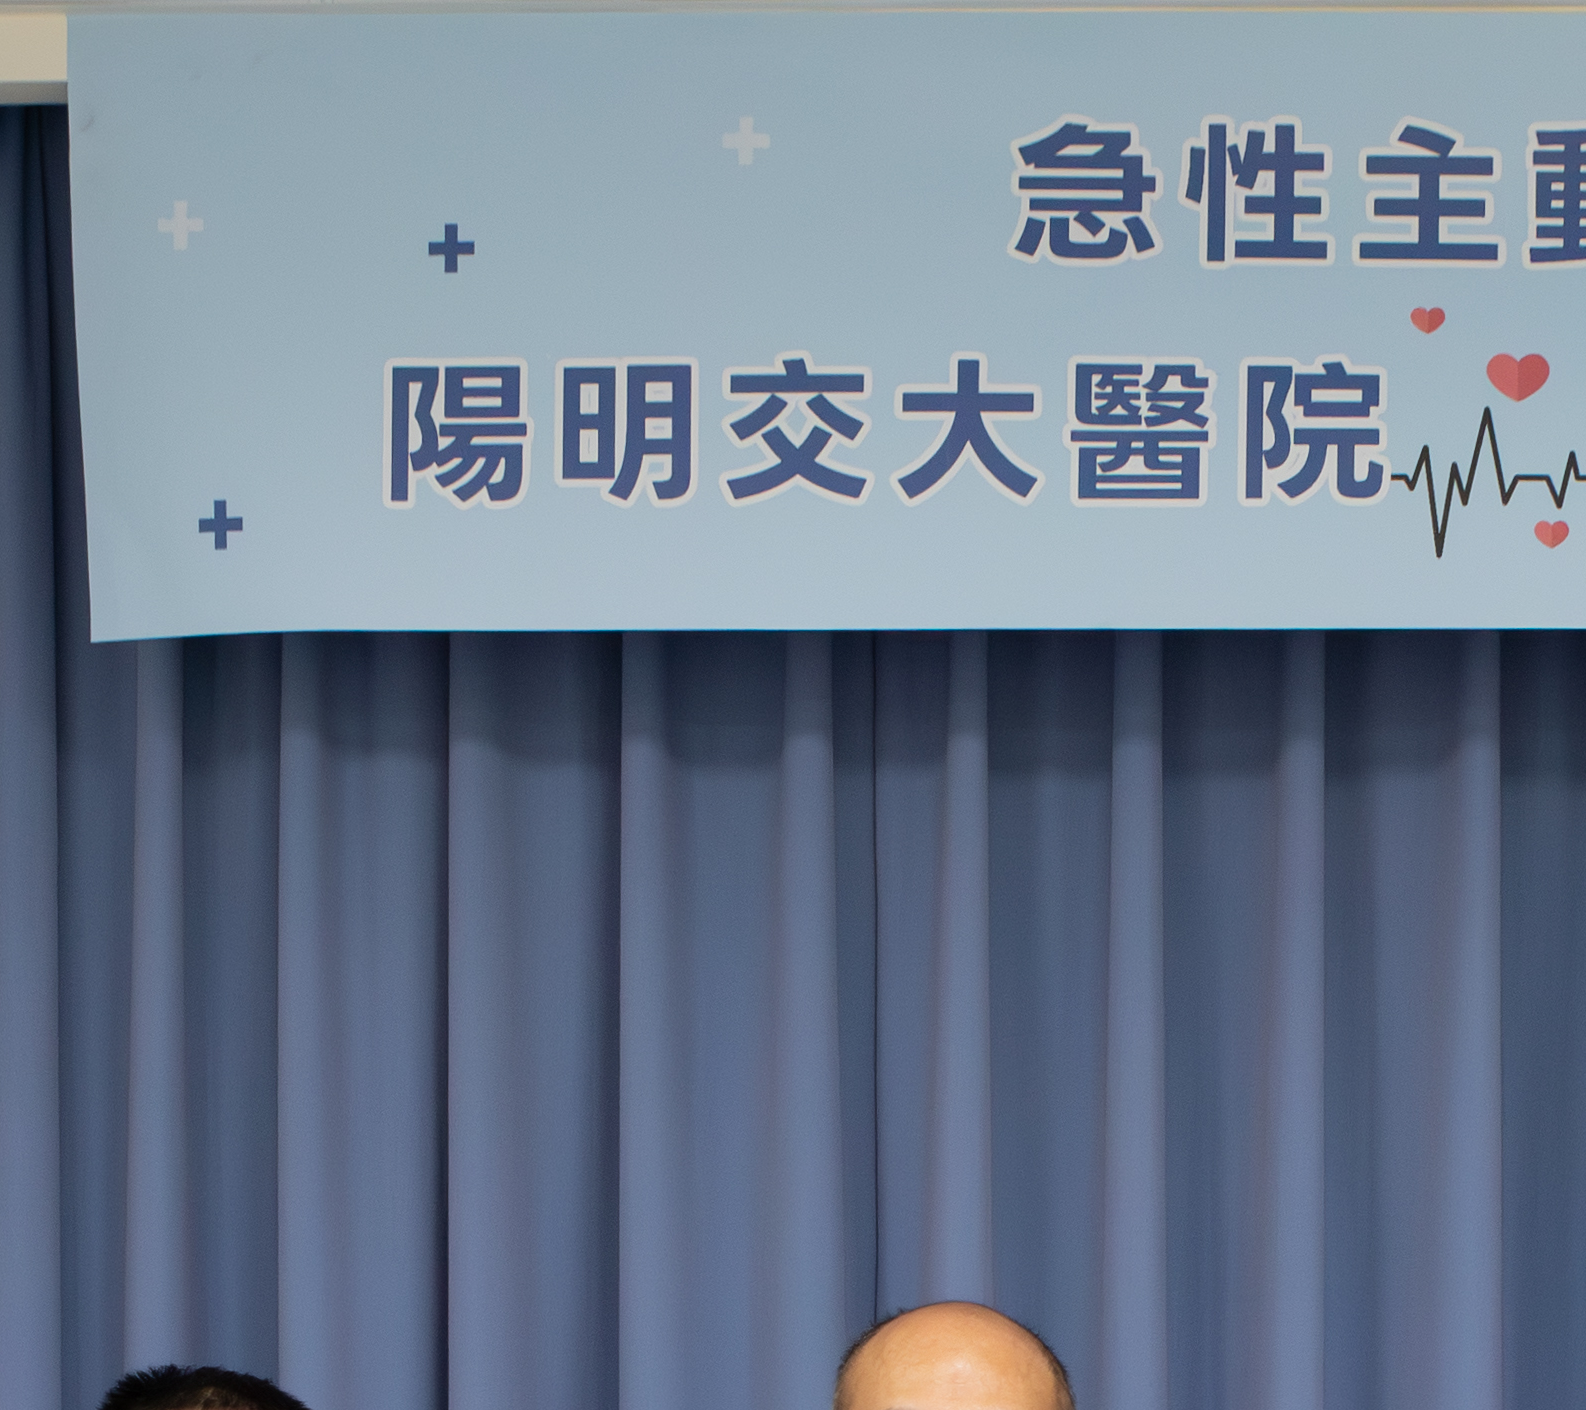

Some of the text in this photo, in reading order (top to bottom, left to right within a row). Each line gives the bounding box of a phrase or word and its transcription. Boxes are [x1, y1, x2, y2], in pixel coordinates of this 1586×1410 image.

[390, 359, 1390, 505] 陽明交大醫院
